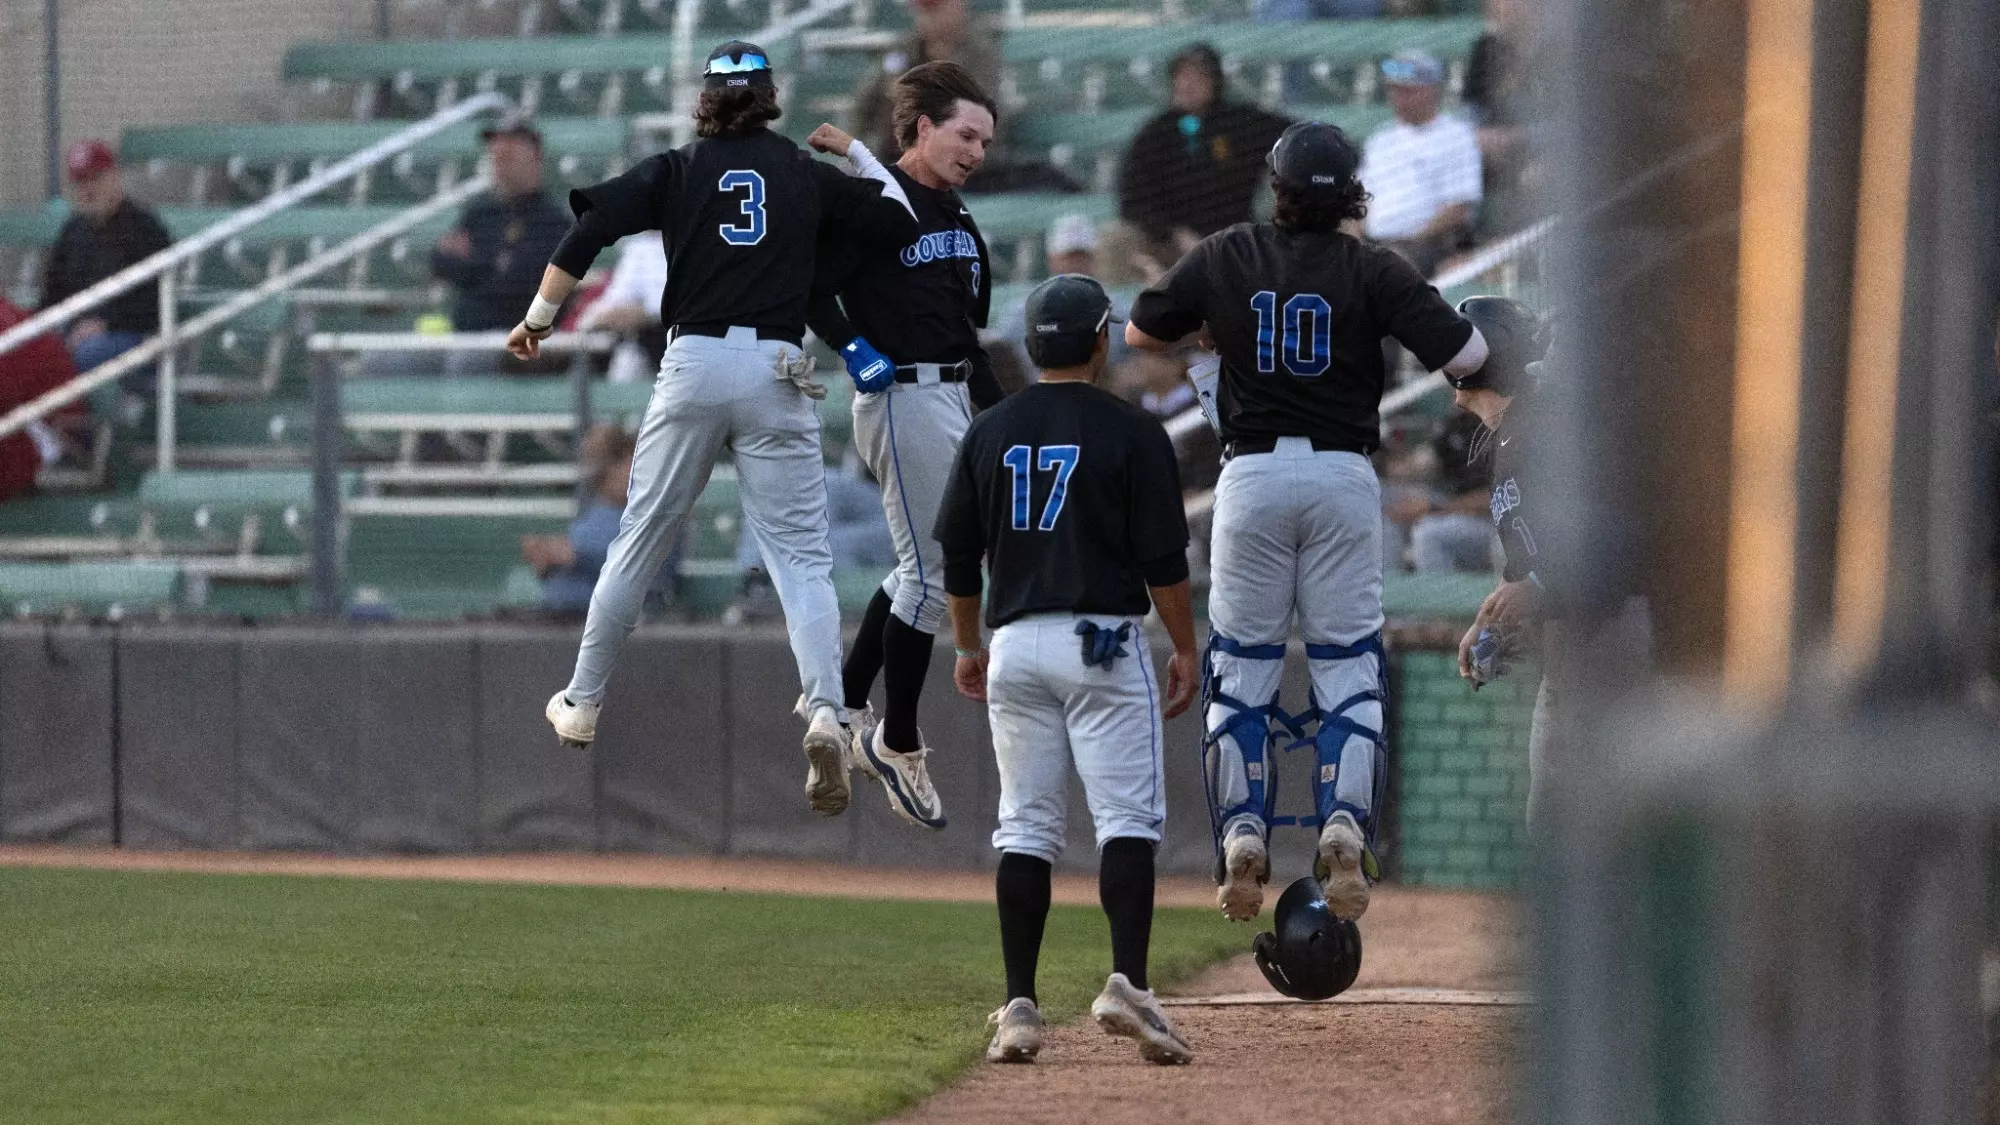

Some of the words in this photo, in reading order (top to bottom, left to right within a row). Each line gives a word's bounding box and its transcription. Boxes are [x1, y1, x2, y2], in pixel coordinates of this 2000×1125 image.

[719, 169, 767, 246] 3
[1250, 290, 1332, 376] 10
[1003, 444, 1081, 531] 17
[1512, 515, 1538, 556] 1
